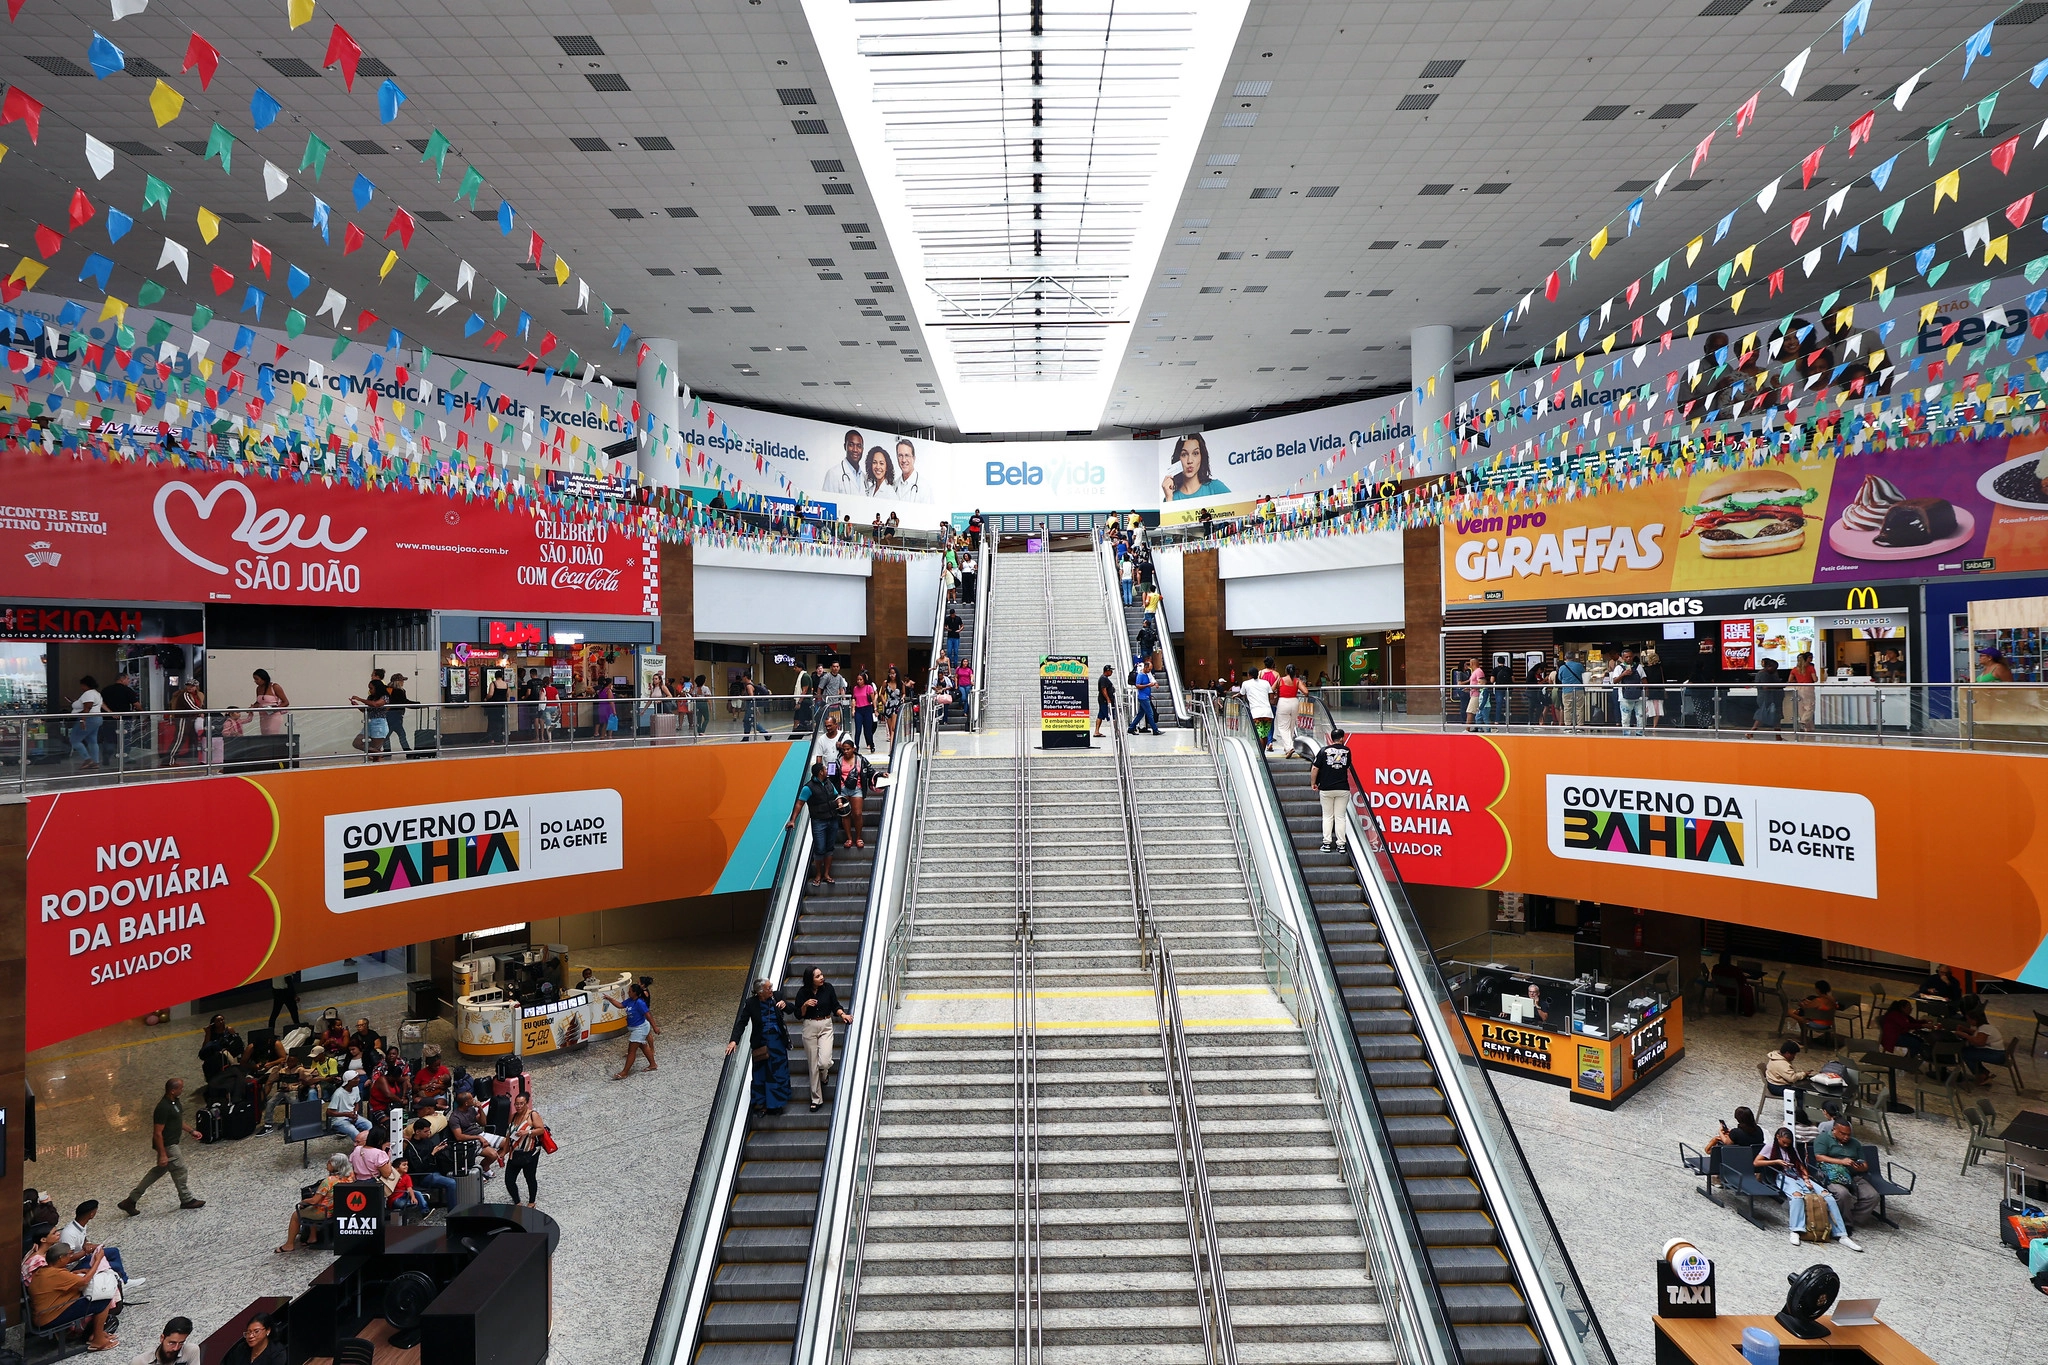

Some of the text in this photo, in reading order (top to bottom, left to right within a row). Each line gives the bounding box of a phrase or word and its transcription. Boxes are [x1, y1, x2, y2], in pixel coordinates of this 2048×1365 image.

[708, 437, 809, 462] especialidade.
[1228, 423, 1413, 465] Cartão Bela Vida. Qualida
[986, 462, 1043, 485] Bela
[45, 521, 107, 535] JUNINO!
[71, 511, 99, 522] SEU
[153, 480, 367, 575] Meu
[1457, 511, 1546, 536] Vem pro
[535, 519, 596, 543] CELEBRE
[396, 541, 509, 555] www.meusaojoao.com.br
[540, 542, 604, 566] SÃO JOÃO
[235, 555, 360, 593] SÃO JOÃO
[517, 566, 622, 592] COM Coca-Cola
[1565, 598, 1704, 621] McDonald's
[1744, 593, 1787, 611] McCafé
[1724, 623, 1751, 632] FREE
[1834, 616, 1891, 625] sobremesas
[41, 632, 92, 640] presentes
[110, 632, 136, 640] geral
[489, 621, 541, 647] Bob's
[1375, 768, 1433, 786] NOVA
[1563, 786, 1743, 819] GOVERNO DA
[343, 808, 518, 850] GOVERNO DA
[540, 817, 605, 835] DO LADO
[1390, 816, 1453, 836] BAHIA
[1563, 808, 1745, 867] BAHIA
[1769, 819, 1851, 842] DO LADO
[540, 832, 607, 851] DA GENTE
[1373, 841, 1442, 857] SALVADOR
[1769, 837, 1855, 862] DA GENTE
[96, 836, 180, 872] NOVA
[343, 831, 520, 899] BAHIA
[41, 863, 229, 923] RODOVIÁRIA
[69, 903, 206, 956] DA BAHIA
[90, 943, 192, 986] SALVADOR
[533, 1017, 554, 1029] QUERO!
[1481, 1024, 1551, 1050] LIGHT
[1483, 1042, 1511, 1053] RENT
[1525, 1050, 1547, 1061] CAR
[1637, 1054, 1651, 1067] RENT
[1657, 1041, 1667, 1053] CAR
[337, 1213, 377, 1229] TÁXI
[1667, 1285, 1711, 1304] TAXI
